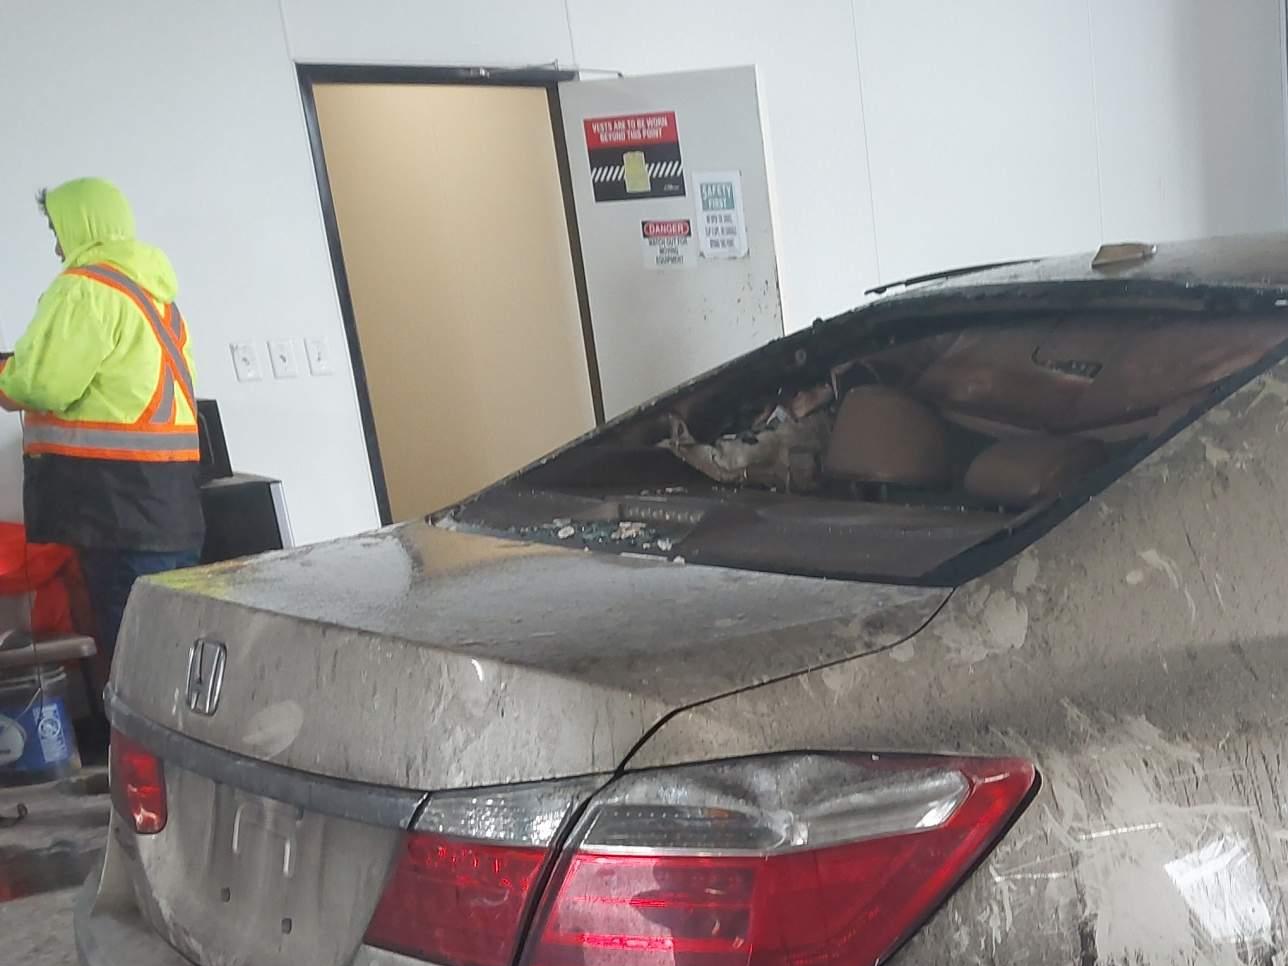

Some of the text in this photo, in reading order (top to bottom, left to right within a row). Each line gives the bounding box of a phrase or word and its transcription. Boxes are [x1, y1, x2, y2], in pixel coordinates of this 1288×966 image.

[592, 115, 668, 133] VESTS ARE TO BE WORN
[600, 127, 662, 143] BEYOND THIS POINT
[702, 183, 731, 199] SAFETY
[709, 198, 727, 209] FIRST
[650, 222, 684, 235] DANGER
[656, 255, 684, 264] EQUIPMENT
